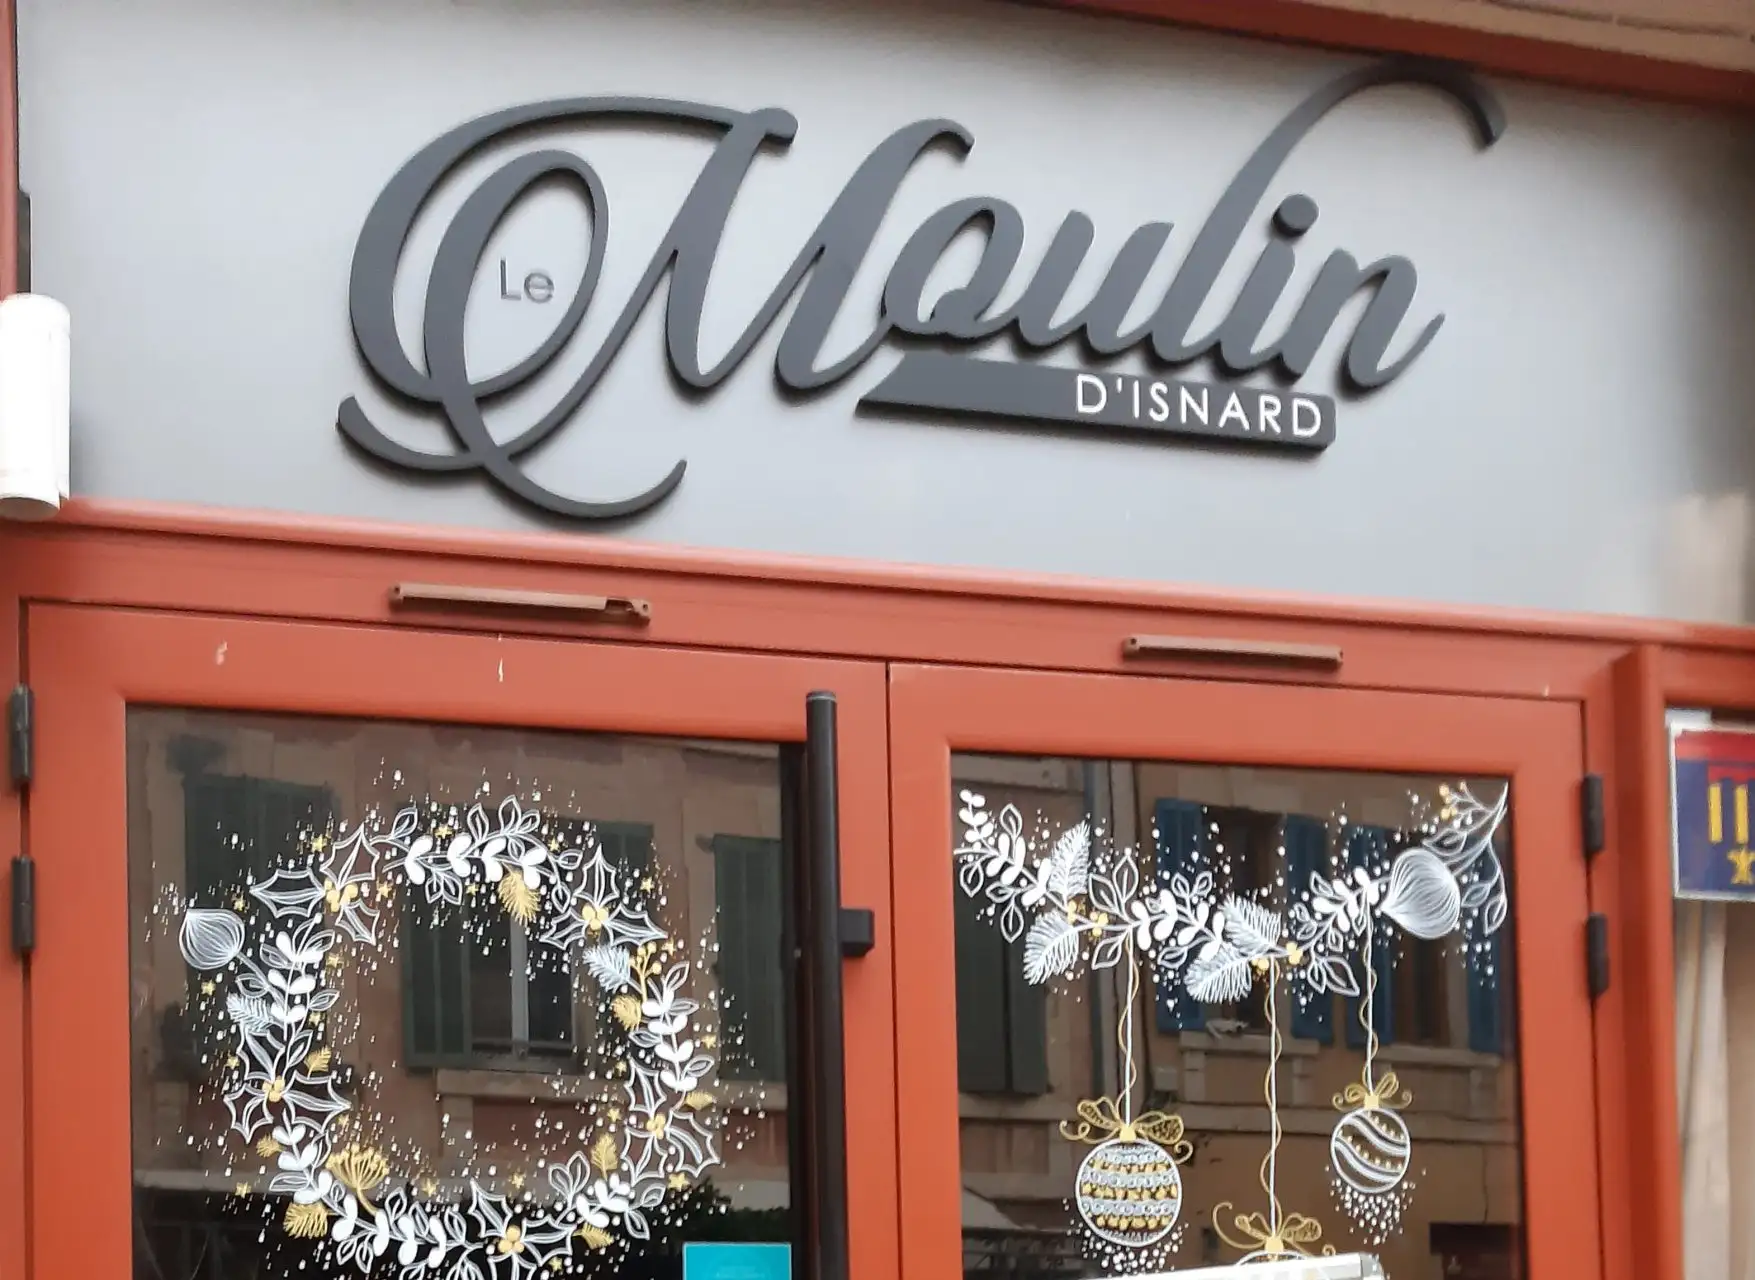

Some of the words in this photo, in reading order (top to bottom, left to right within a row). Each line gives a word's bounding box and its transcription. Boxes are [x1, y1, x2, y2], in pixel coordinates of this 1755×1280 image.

[337, 54, 1506, 518] Moulin
[500, 258, 555, 304] Le
[1075, 373, 1322, 437] D'ISNARD
